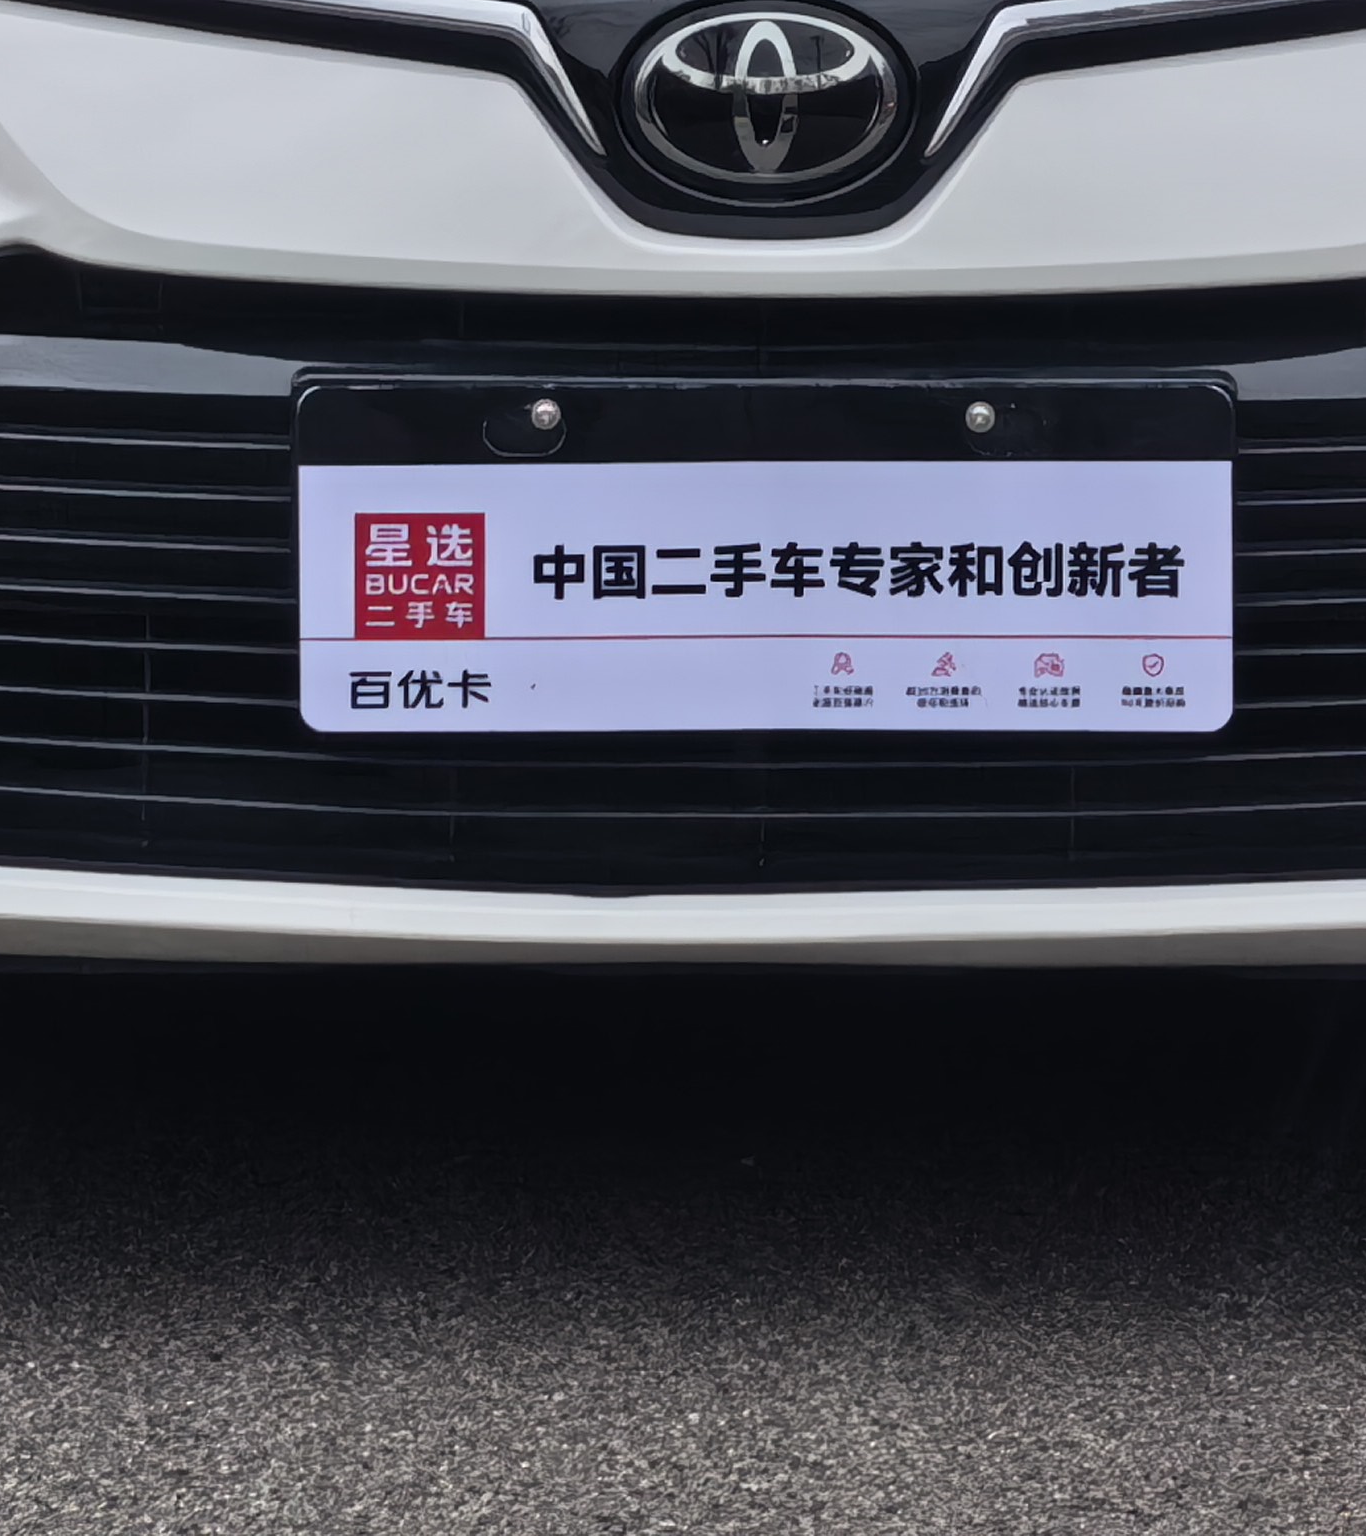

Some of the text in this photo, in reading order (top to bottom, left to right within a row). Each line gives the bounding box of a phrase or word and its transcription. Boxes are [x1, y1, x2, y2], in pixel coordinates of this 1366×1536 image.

[365, 523, 474, 567] 星选
[365, 573, 475, 595] BUCAR
[533, 541, 1186, 600] 中国二手车专家和创新者
[365, 601, 474, 629] 二手车
[349, 669, 492, 709] 百优卡
